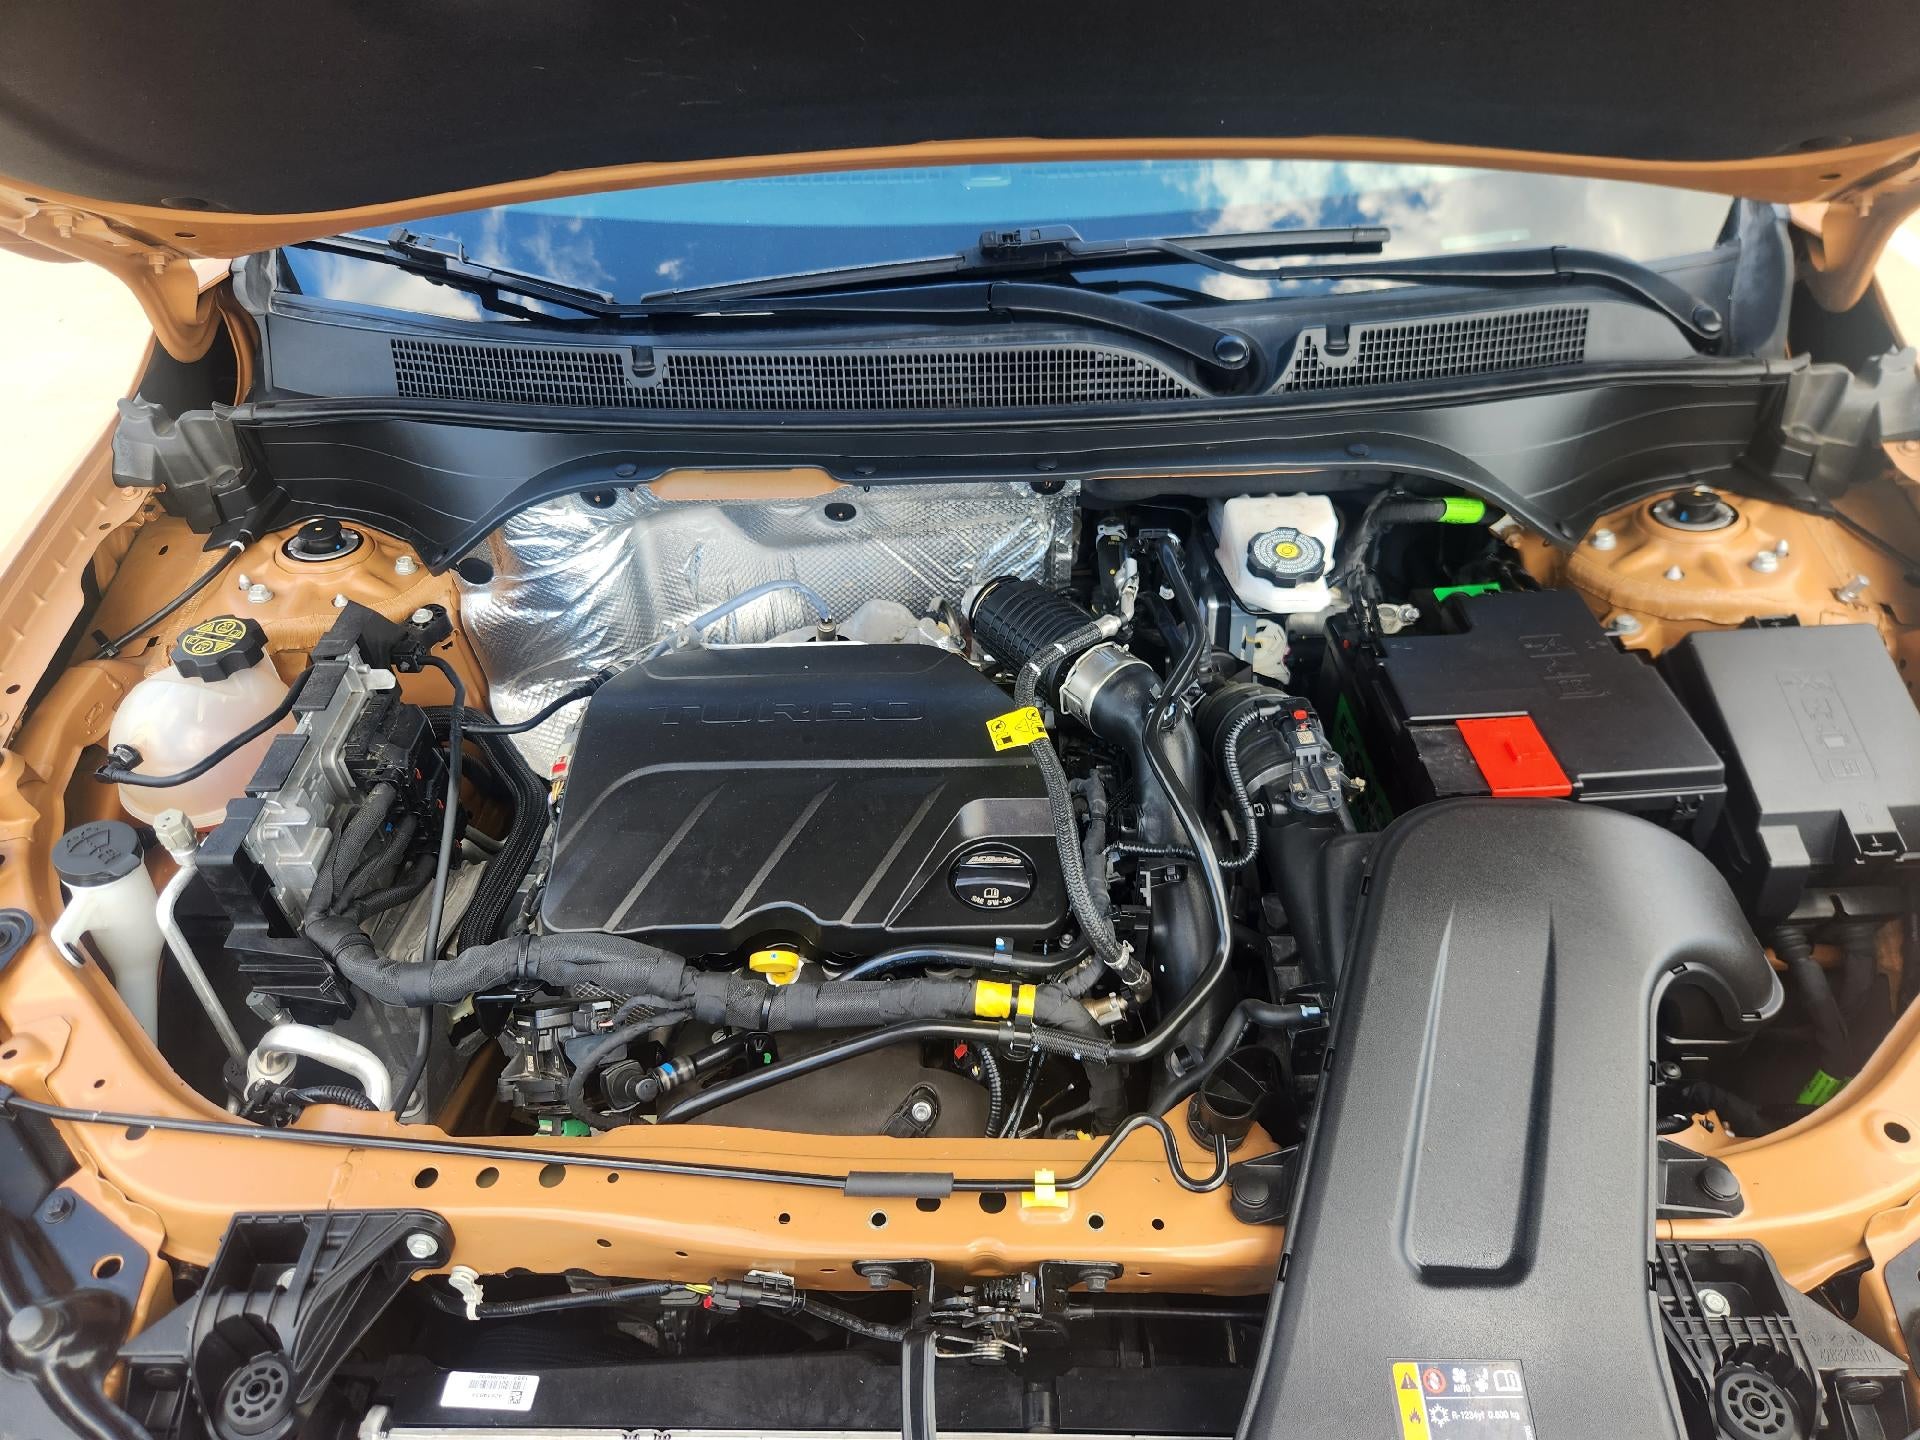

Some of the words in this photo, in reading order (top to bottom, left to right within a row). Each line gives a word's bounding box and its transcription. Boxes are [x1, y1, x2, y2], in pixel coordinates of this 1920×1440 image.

[649, 702, 923, 725] TURBO
[971, 895, 985, 905] SAE
[987, 896, 1012, 906] 5W-30
[1453, 1384, 1472, 1393] AUTO
[1510, 1410, 1520, 1421] kg
